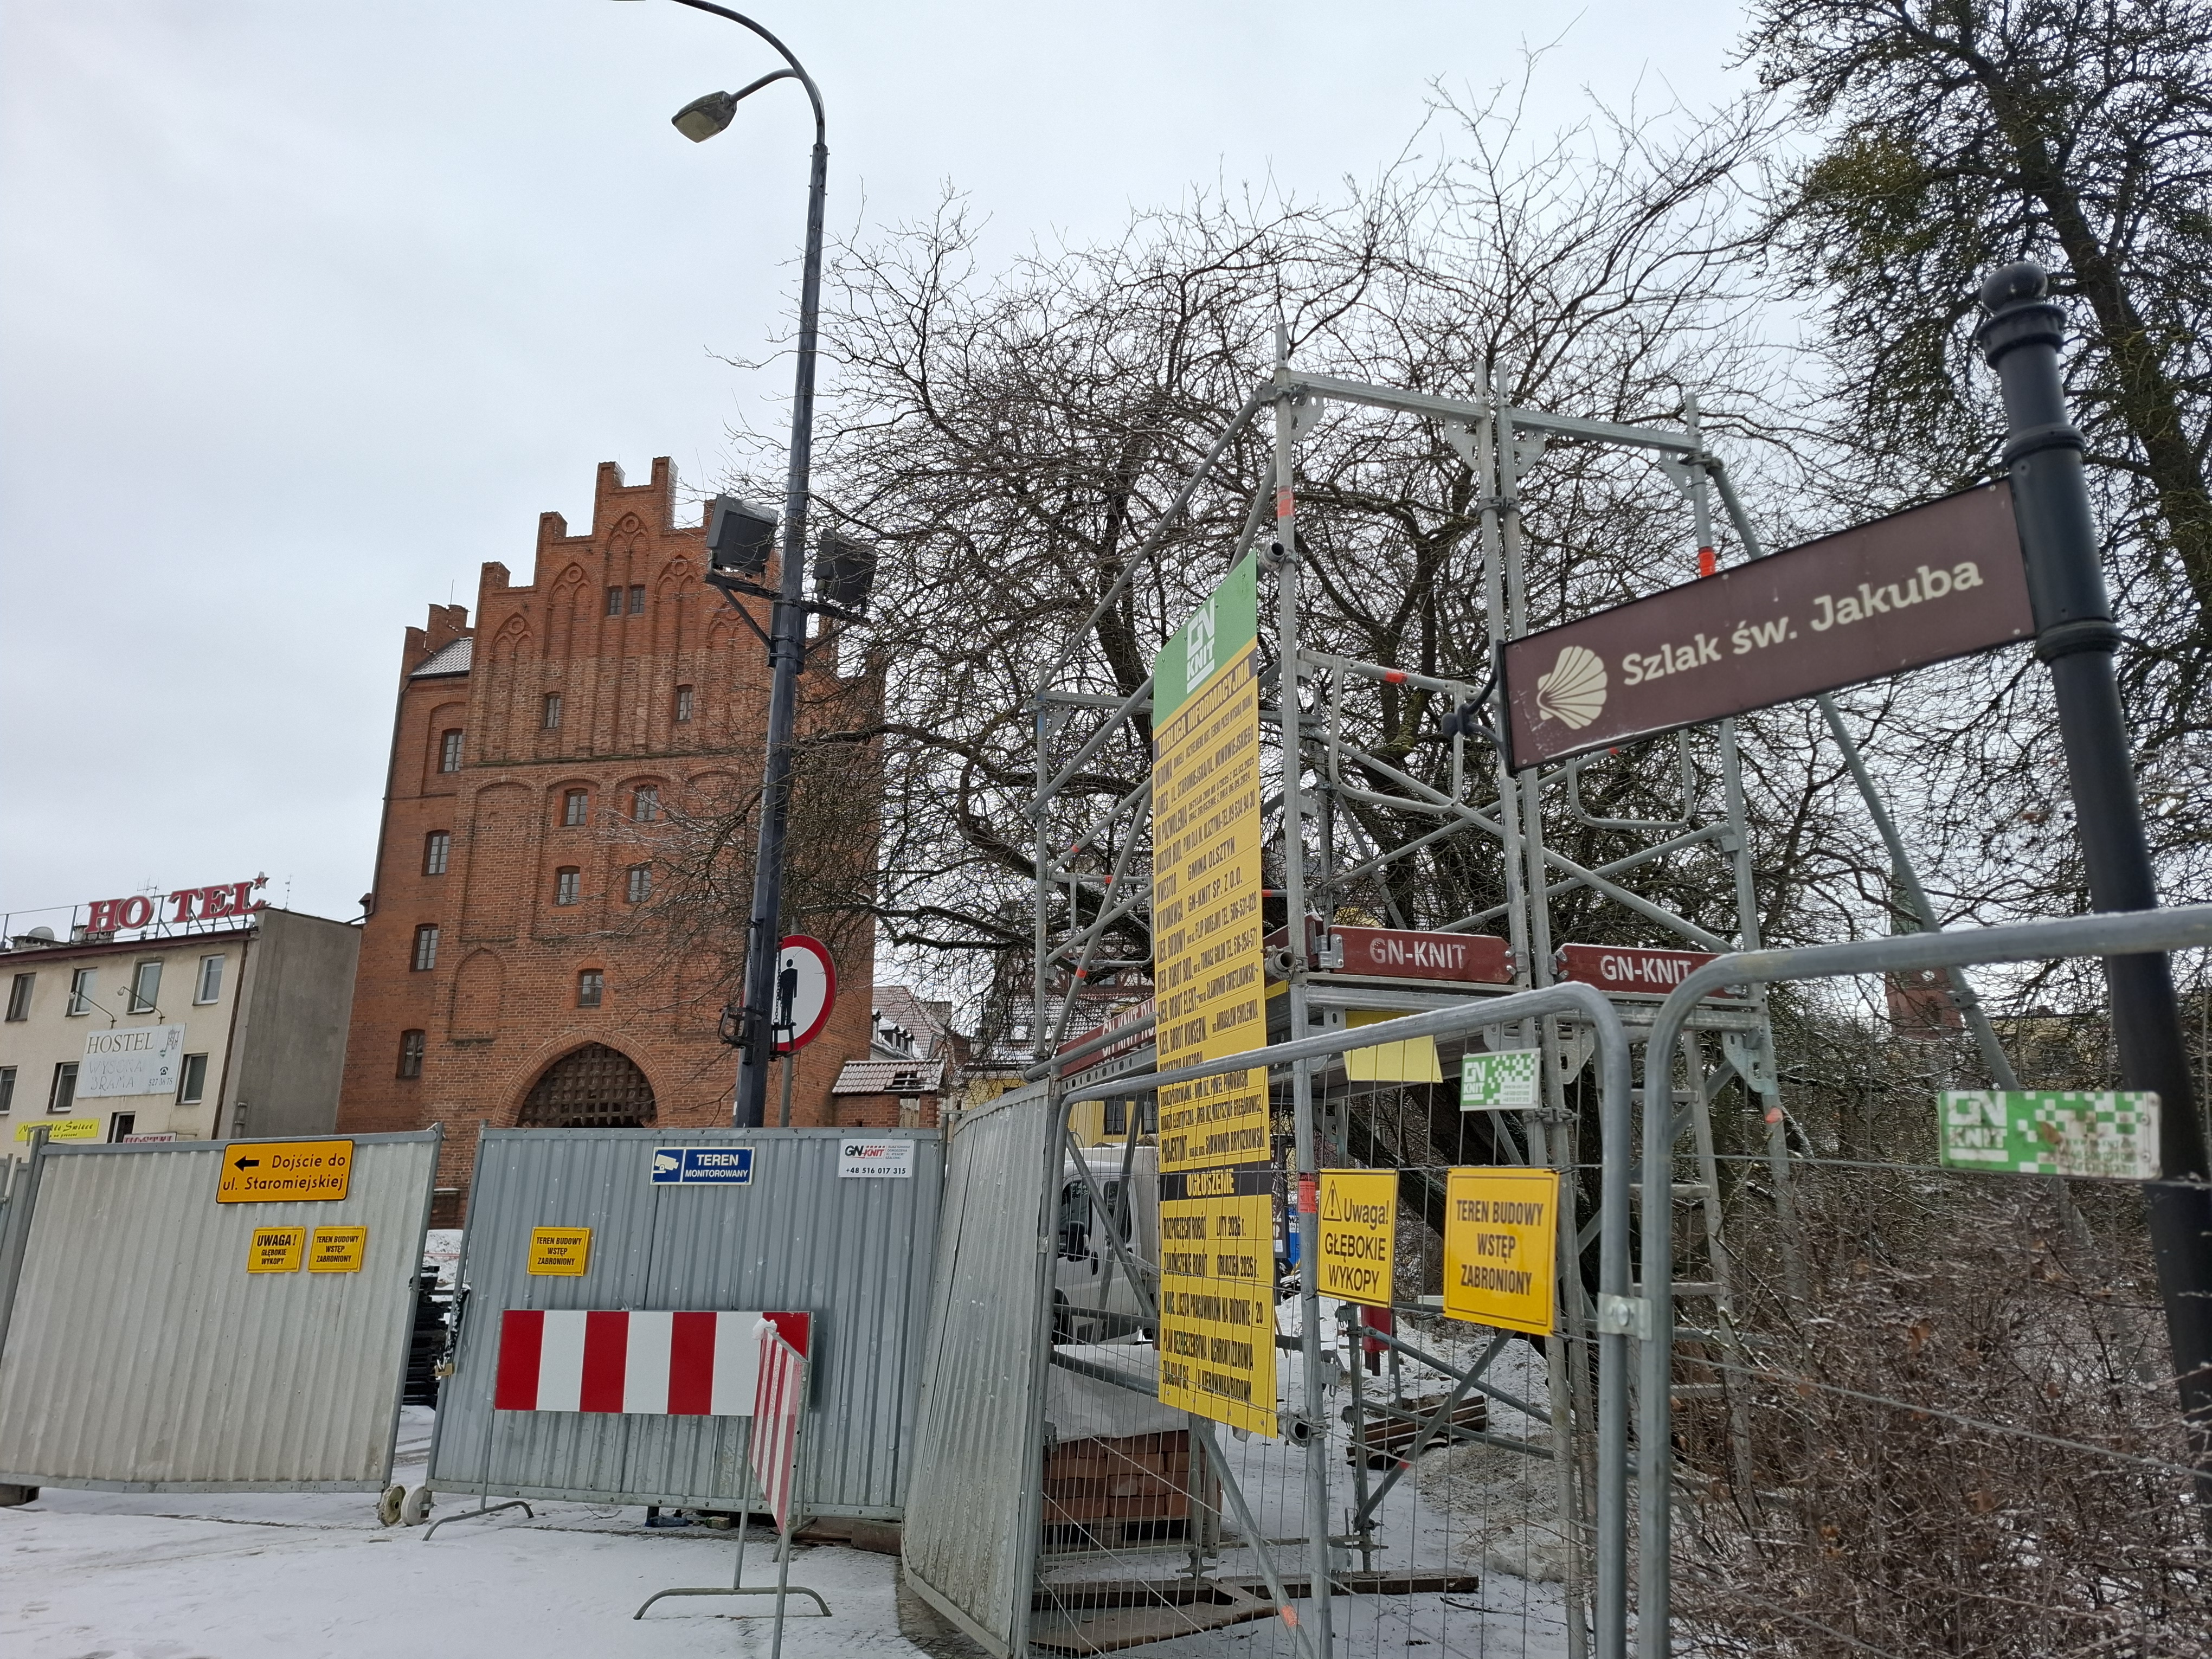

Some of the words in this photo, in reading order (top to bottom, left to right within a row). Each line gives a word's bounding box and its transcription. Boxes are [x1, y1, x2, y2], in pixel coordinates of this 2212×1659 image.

[1187, 596, 1214, 660] GN
[1622, 633, 1722, 685] Szlak
[1731, 616, 1797, 654] św.
[1810, 562, 1983, 631] Jakuba
[1187, 637, 1214, 681] KNIT
[1158, 715, 1185, 758] TABLICA
[1187, 657, 1250, 732] INFORMACYJNA
[1155, 789, 1168, 819] ADRES
[1215, 723, 1253, 769] NOWOWIEJSKIEGO
[1155, 757, 1172, 792] BUDOWA
[1155, 824, 1161, 847] NR
[1162, 803, 1187, 843] POZWOLENIA
[1230, 771, 1232, 781] Z
[1232, 755, 1253, 779] 03.03.2025
[1156, 839, 1171, 876] NADZÓR
[1173, 837, 1182, 865] BUD.
[1243, 792, 1249, 814] 94
[1249, 788, 1255, 809] 30
[1156, 871, 1176, 905] INWESTOR
[1187, 853, 1206, 882] GMINA
[1208, 835, 1234, 869] OLSZTYN
[1156, 897, 1183, 935] WYKONAWCA
[1188, 883, 1211, 912] GN-KNIT
[1212, 876, 1222, 899] SP.
[1224, 873, 1227, 892] Z
[1230, 864, 1242, 889] O.O.
[1157, 937, 1167, 964] KIER.
[1168, 927, 1186, 959] BUDOWY
[1195, 918, 1203, 940] FILIP
[1204, 909, 1220, 935] BOREJKO
[1221, 905, 1229, 927] TEL.
[1230, 890, 1257, 922] 506-531-028
[1158, 967, 1167, 994] KIER.
[1168, 954, 1182, 989] ROBÓT
[1182, 955, 1193, 983] BUD.
[1201, 947, 1214, 970] TOMASZ
[1233, 925, 1257, 955] 516-254-571
[1370, 937, 1466, 969] GN-KNIT
[1600, 955, 1692, 984] GN-KNIT
[1158, 998, 1168, 1025] KIER.
[1169, 985, 1182, 1021] ROBÓT
[1184, 985, 1198, 1015] ELEKT.
[1206, 974, 1225, 1000] SŁAWOMIR
[1225, 956, 1255, 992] ŚWIETLIKOWSKI
[1159, 1029, 1169, 1056] KIER.
[1169, 1017, 1184, 1052] ROBÓT
[1184, 1014, 1207, 1047] KONSERW.
[1217, 1006, 1236, 1031] MIROSŁAW
[1237, 998, 1258, 1025] CHOLEWKA
[86, 1032, 154, 1054] HOSTEL
[1464, 1061, 1486, 1082] GN
[1464, 1082, 1484, 1094] KNIT
[1948, 1091, 2007, 1127] GN
[1949, 1127, 2007, 1148] KNIT
[272, 1154, 322, 1172] Dojście
[328, 1153, 345, 1166] do
[685, 1169, 748, 1178] MONITOROWANY
[697, 1154, 739, 1166] TEREN
[223, 1177, 237, 1191] ul.
[245, 1174, 344, 1192] Staromiejskiej
[1186, 1168, 1234, 1197] OGŁOSZENIE
[1344, 1198, 1390, 1230] Uwaga!
[1456, 1199, 1489, 1222] TEREN
[1493, 1201, 1544, 1226] BUDOWY
[537, 1237, 555, 1245] TEREN
[556, 1237, 582, 1245] BUDOWY
[1163, 1217, 1191, 1248] ROZPOCZĘCIE
[1216, 1216, 1226, 1236] LUTY
[1227, 1216, 1240, 1236] 2026
[1242, 1218, 1246, 1236] r.
[261, 1249, 286, 1258] GŁĘBOKIE
[325, 1246, 345, 1255] WSTĘP
[537, 1257, 575, 1265] ZABRONIONY
[547, 1248, 568, 1257] WSTĘP
[1325, 1232, 1386, 1263] GŁĘBOKIE
[1477, 1233, 1516, 1263] WSTĘP
[1240, 1255, 1253, 1277] 2026
[1328, 1264, 1380, 1294] WYKOPY
[1461, 1264, 1532, 1296] ZABRONIONY
[1222, 1297, 1228, 1322] NA
[1229, 1297, 1250, 1326] BUDOWIE
[1255, 1301, 1263, 1324] 20
